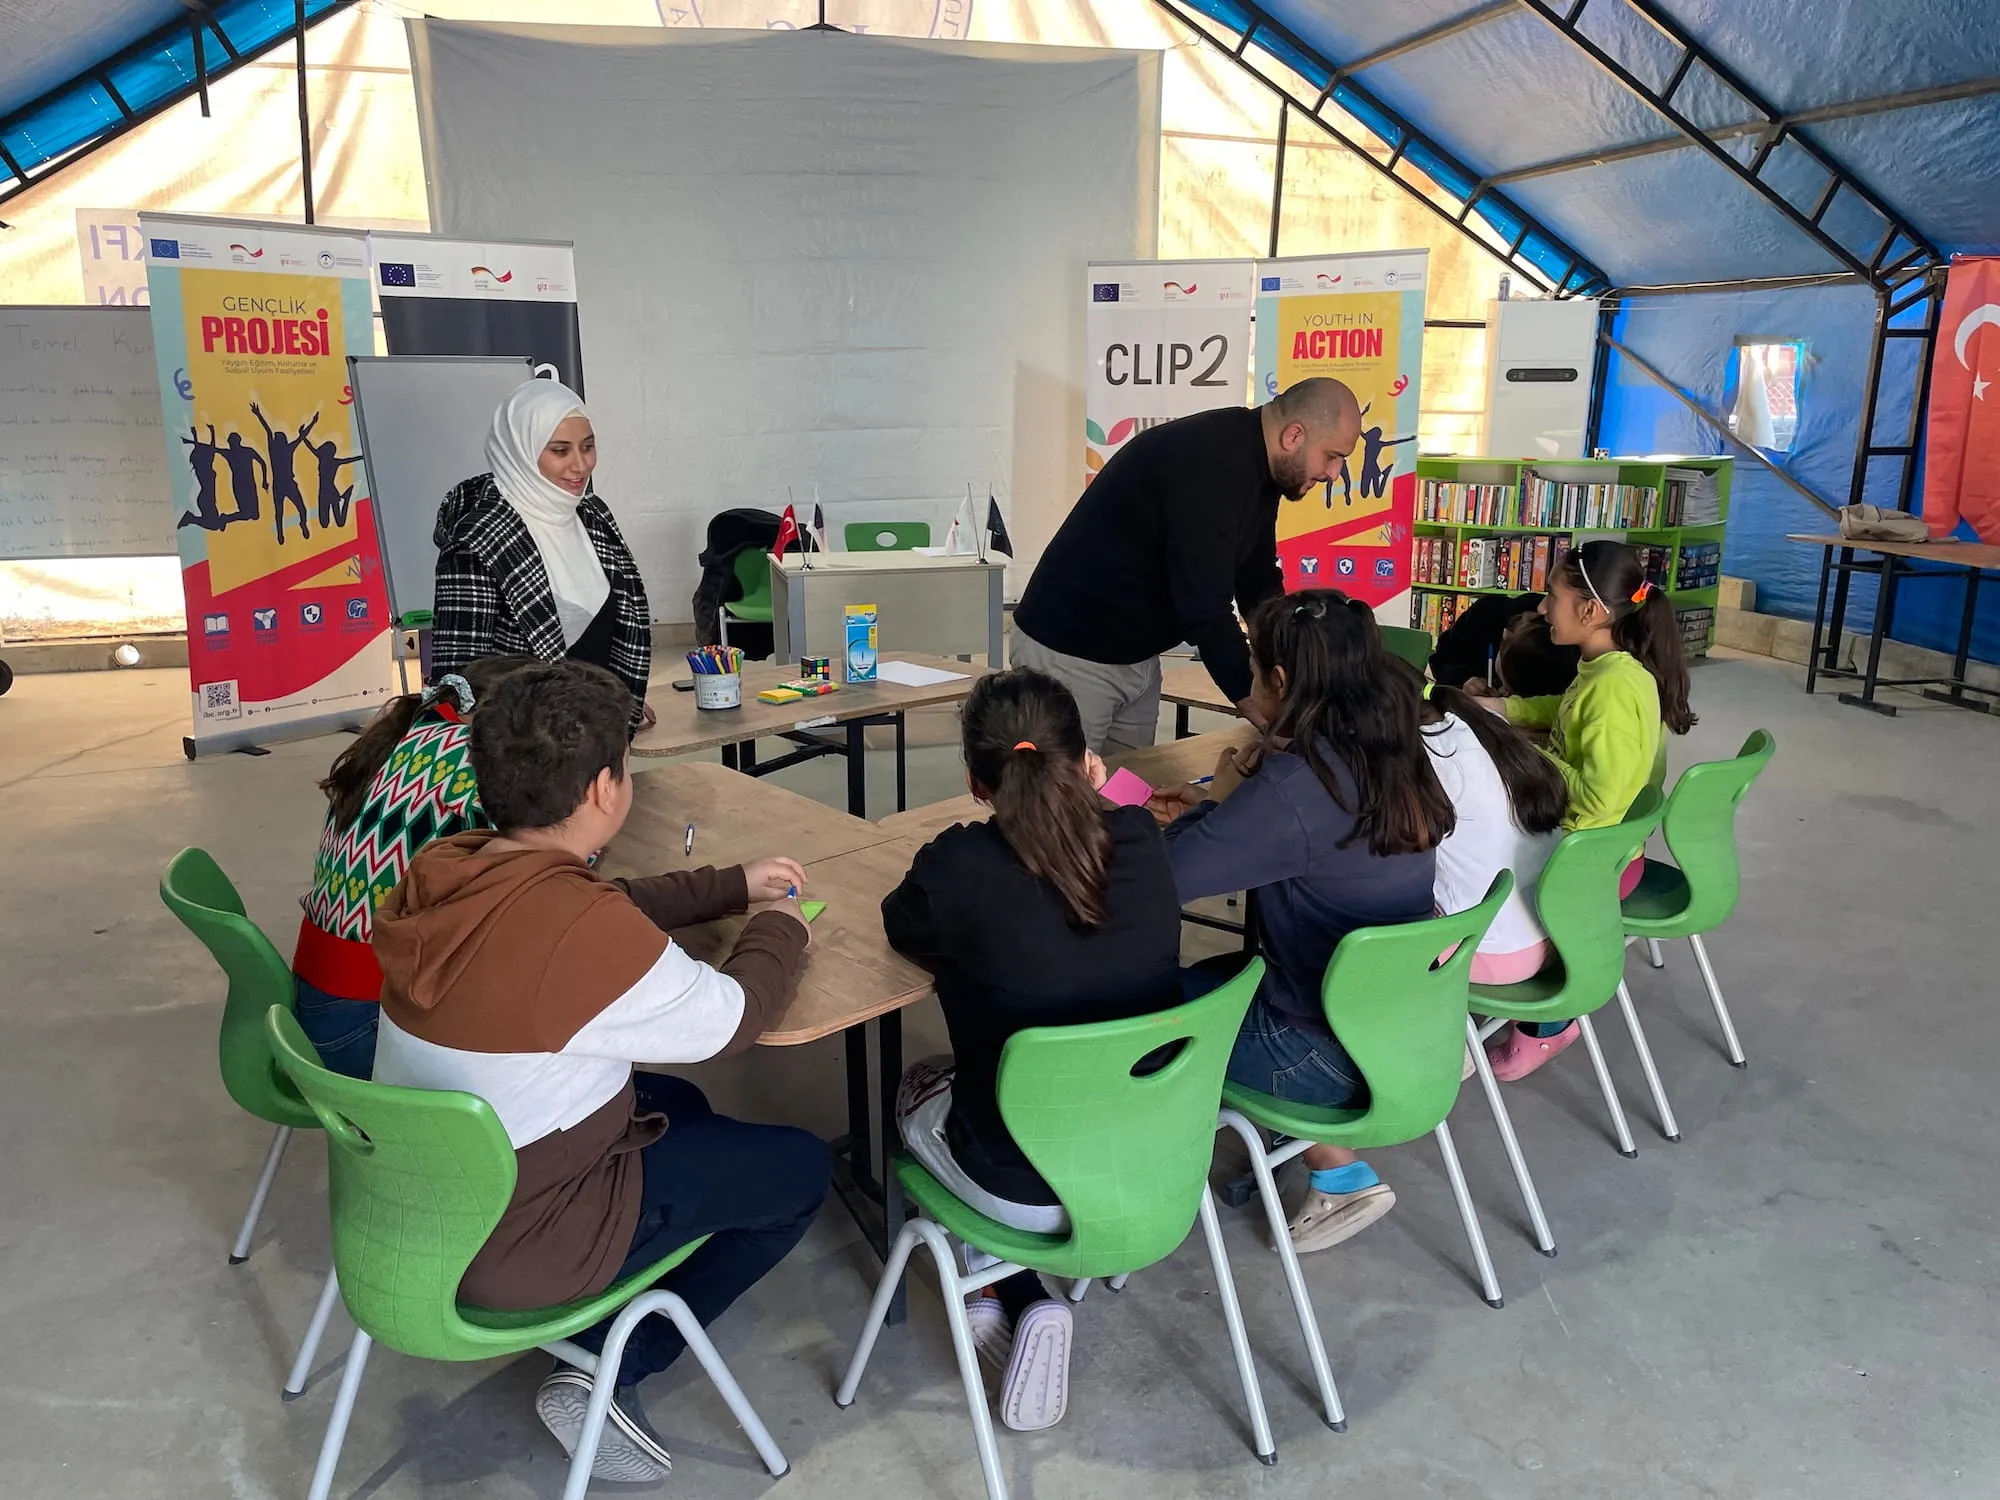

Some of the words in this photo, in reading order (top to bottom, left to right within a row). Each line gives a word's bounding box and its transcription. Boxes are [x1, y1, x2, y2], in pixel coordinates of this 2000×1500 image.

[222, 296, 308, 317] GENÇLİK
[1303, 313, 1354, 327] YOUTH
[1358, 312, 1374, 325] IN
[4, 324, 82, 351] Temel
[201, 308, 330, 356] PROJESİ
[1292, 328, 1383, 360] ACTION
